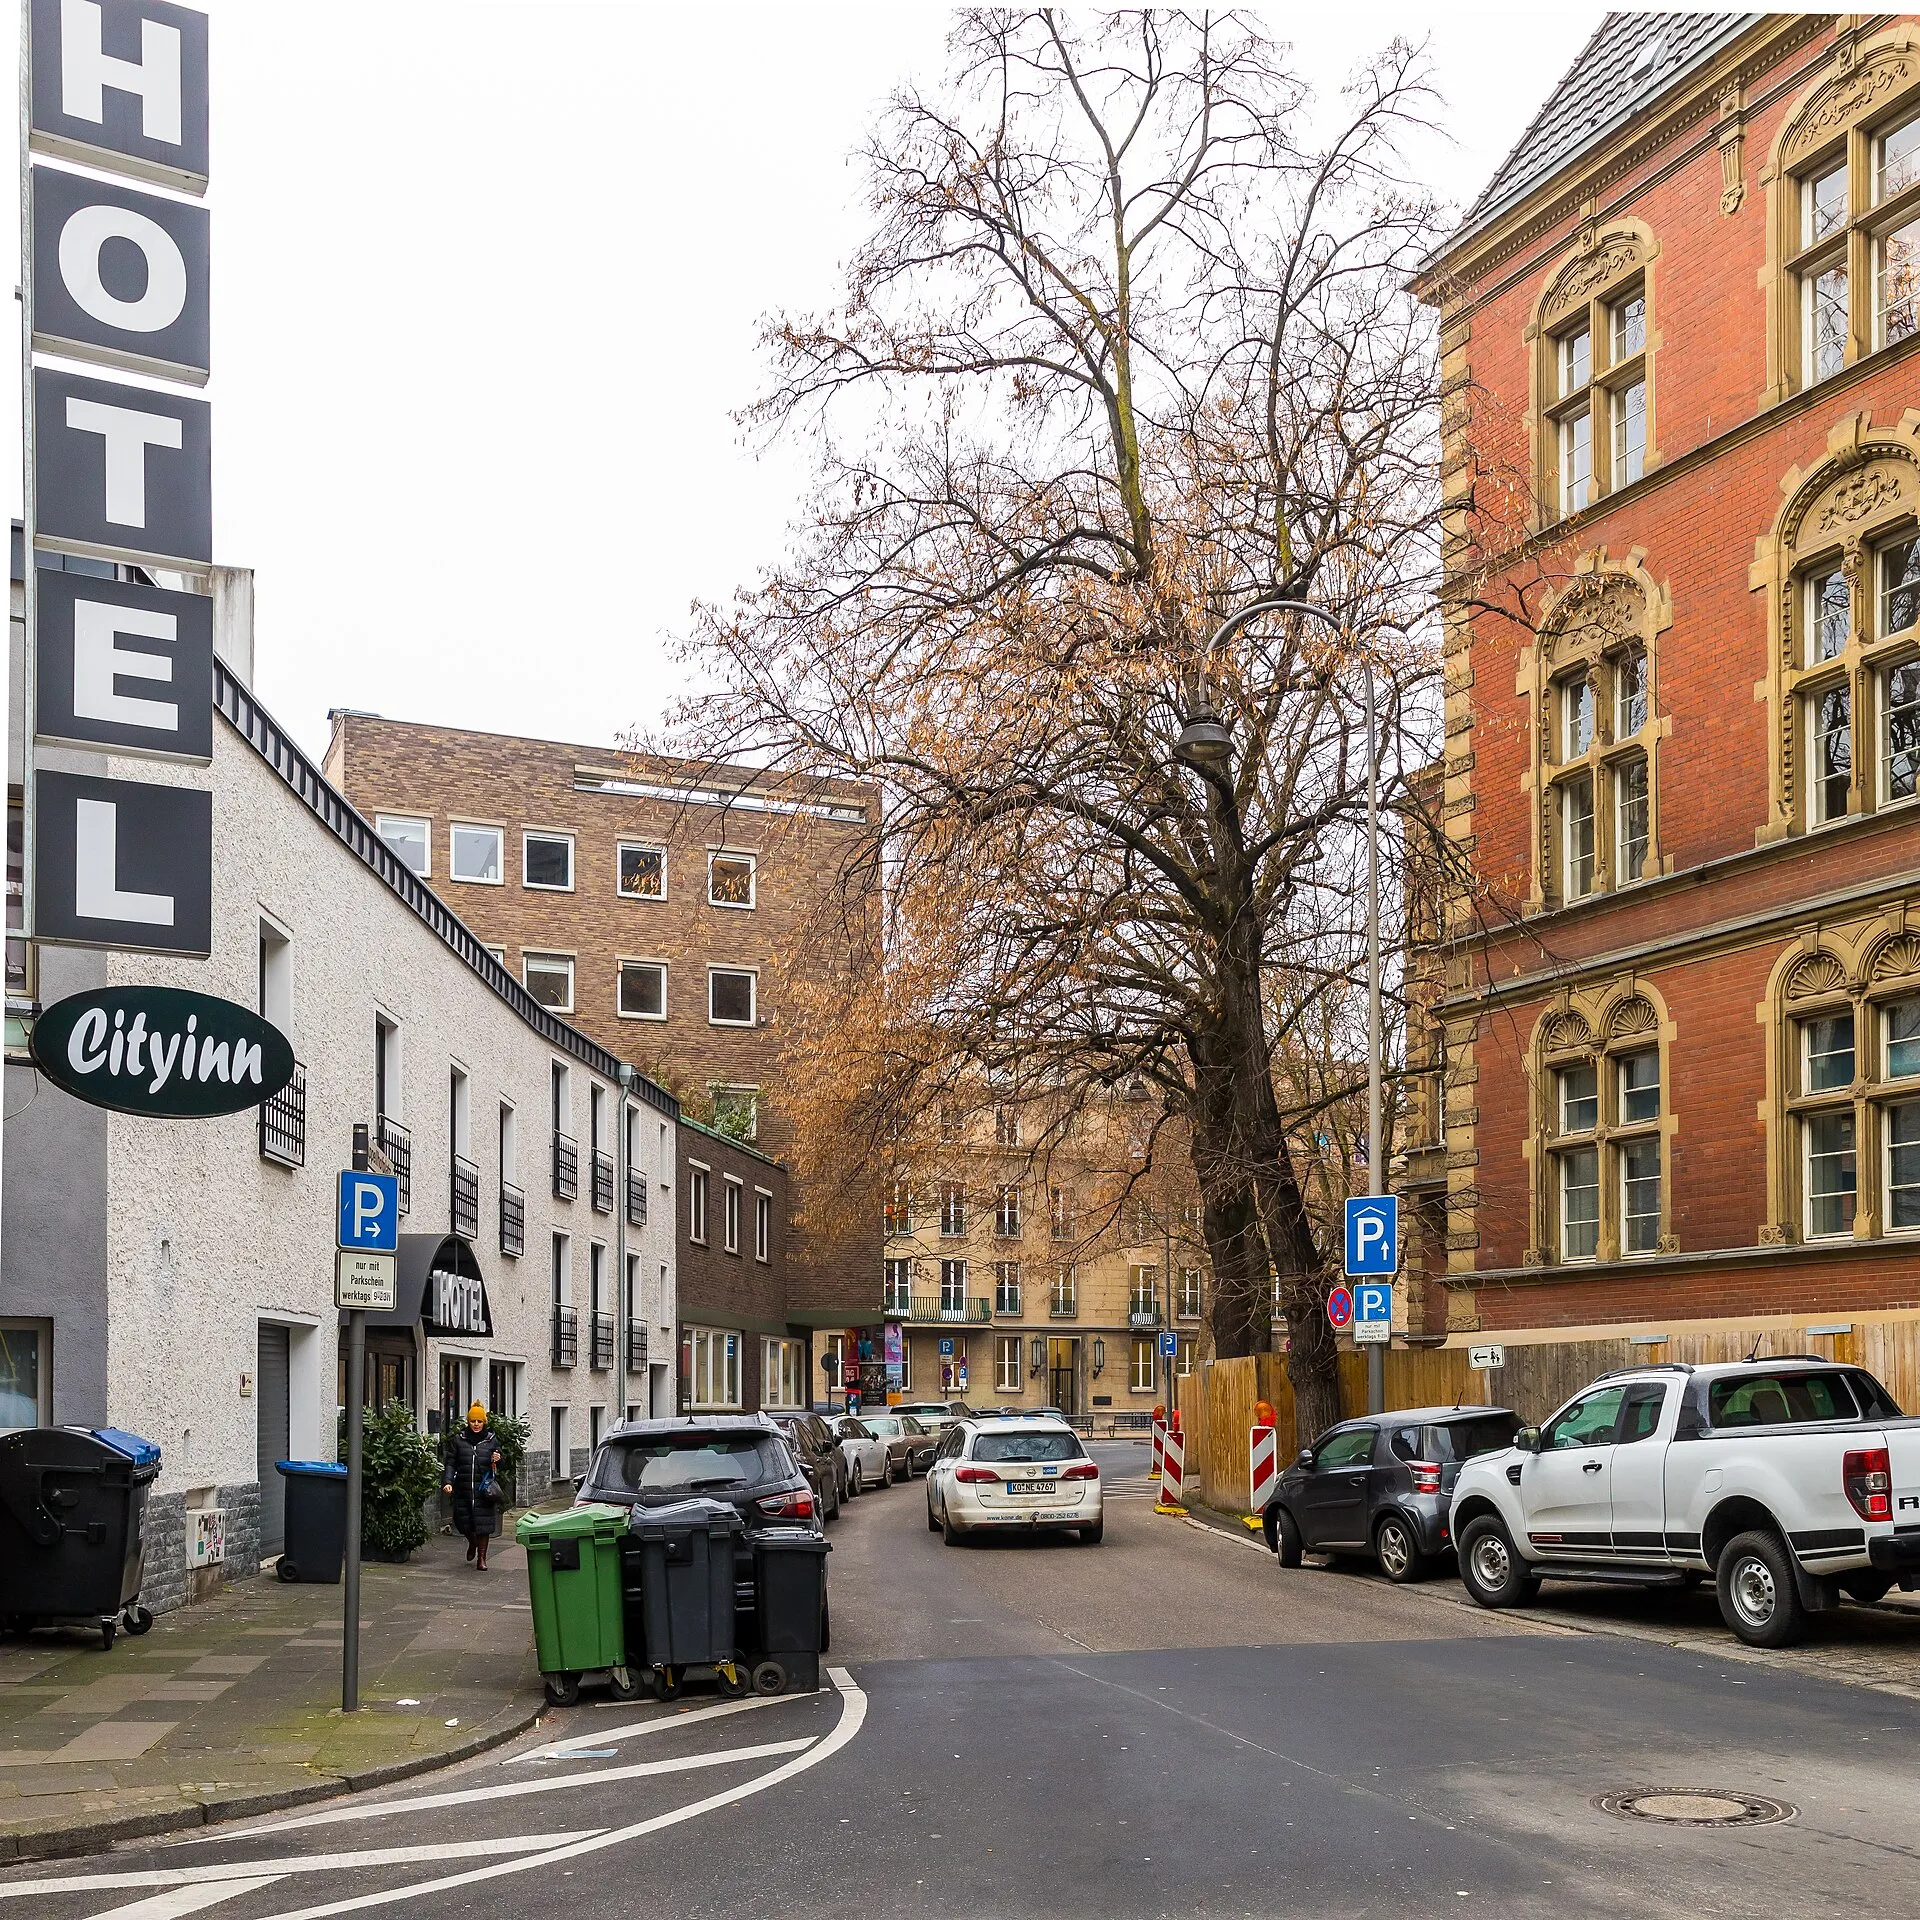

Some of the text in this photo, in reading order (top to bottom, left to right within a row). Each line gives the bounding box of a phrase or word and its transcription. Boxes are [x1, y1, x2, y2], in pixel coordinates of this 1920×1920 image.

[58, 0, 187, 927] HOTEL
[67, 1007, 263, 1094] Cityinn
[353, 1182, 385, 1238] P
[1357, 1217, 1384, 1262] P
[350, 1274, 384, 1287] Parkschein
[355, 1261, 380, 1271] nur mit
[341, 1290, 371, 1303] werktags
[433, 1269, 486, 1333] HOTEL
[1363, 1290, 1383, 1320] P
[1036, 1482, 1054, 1491] 4767
